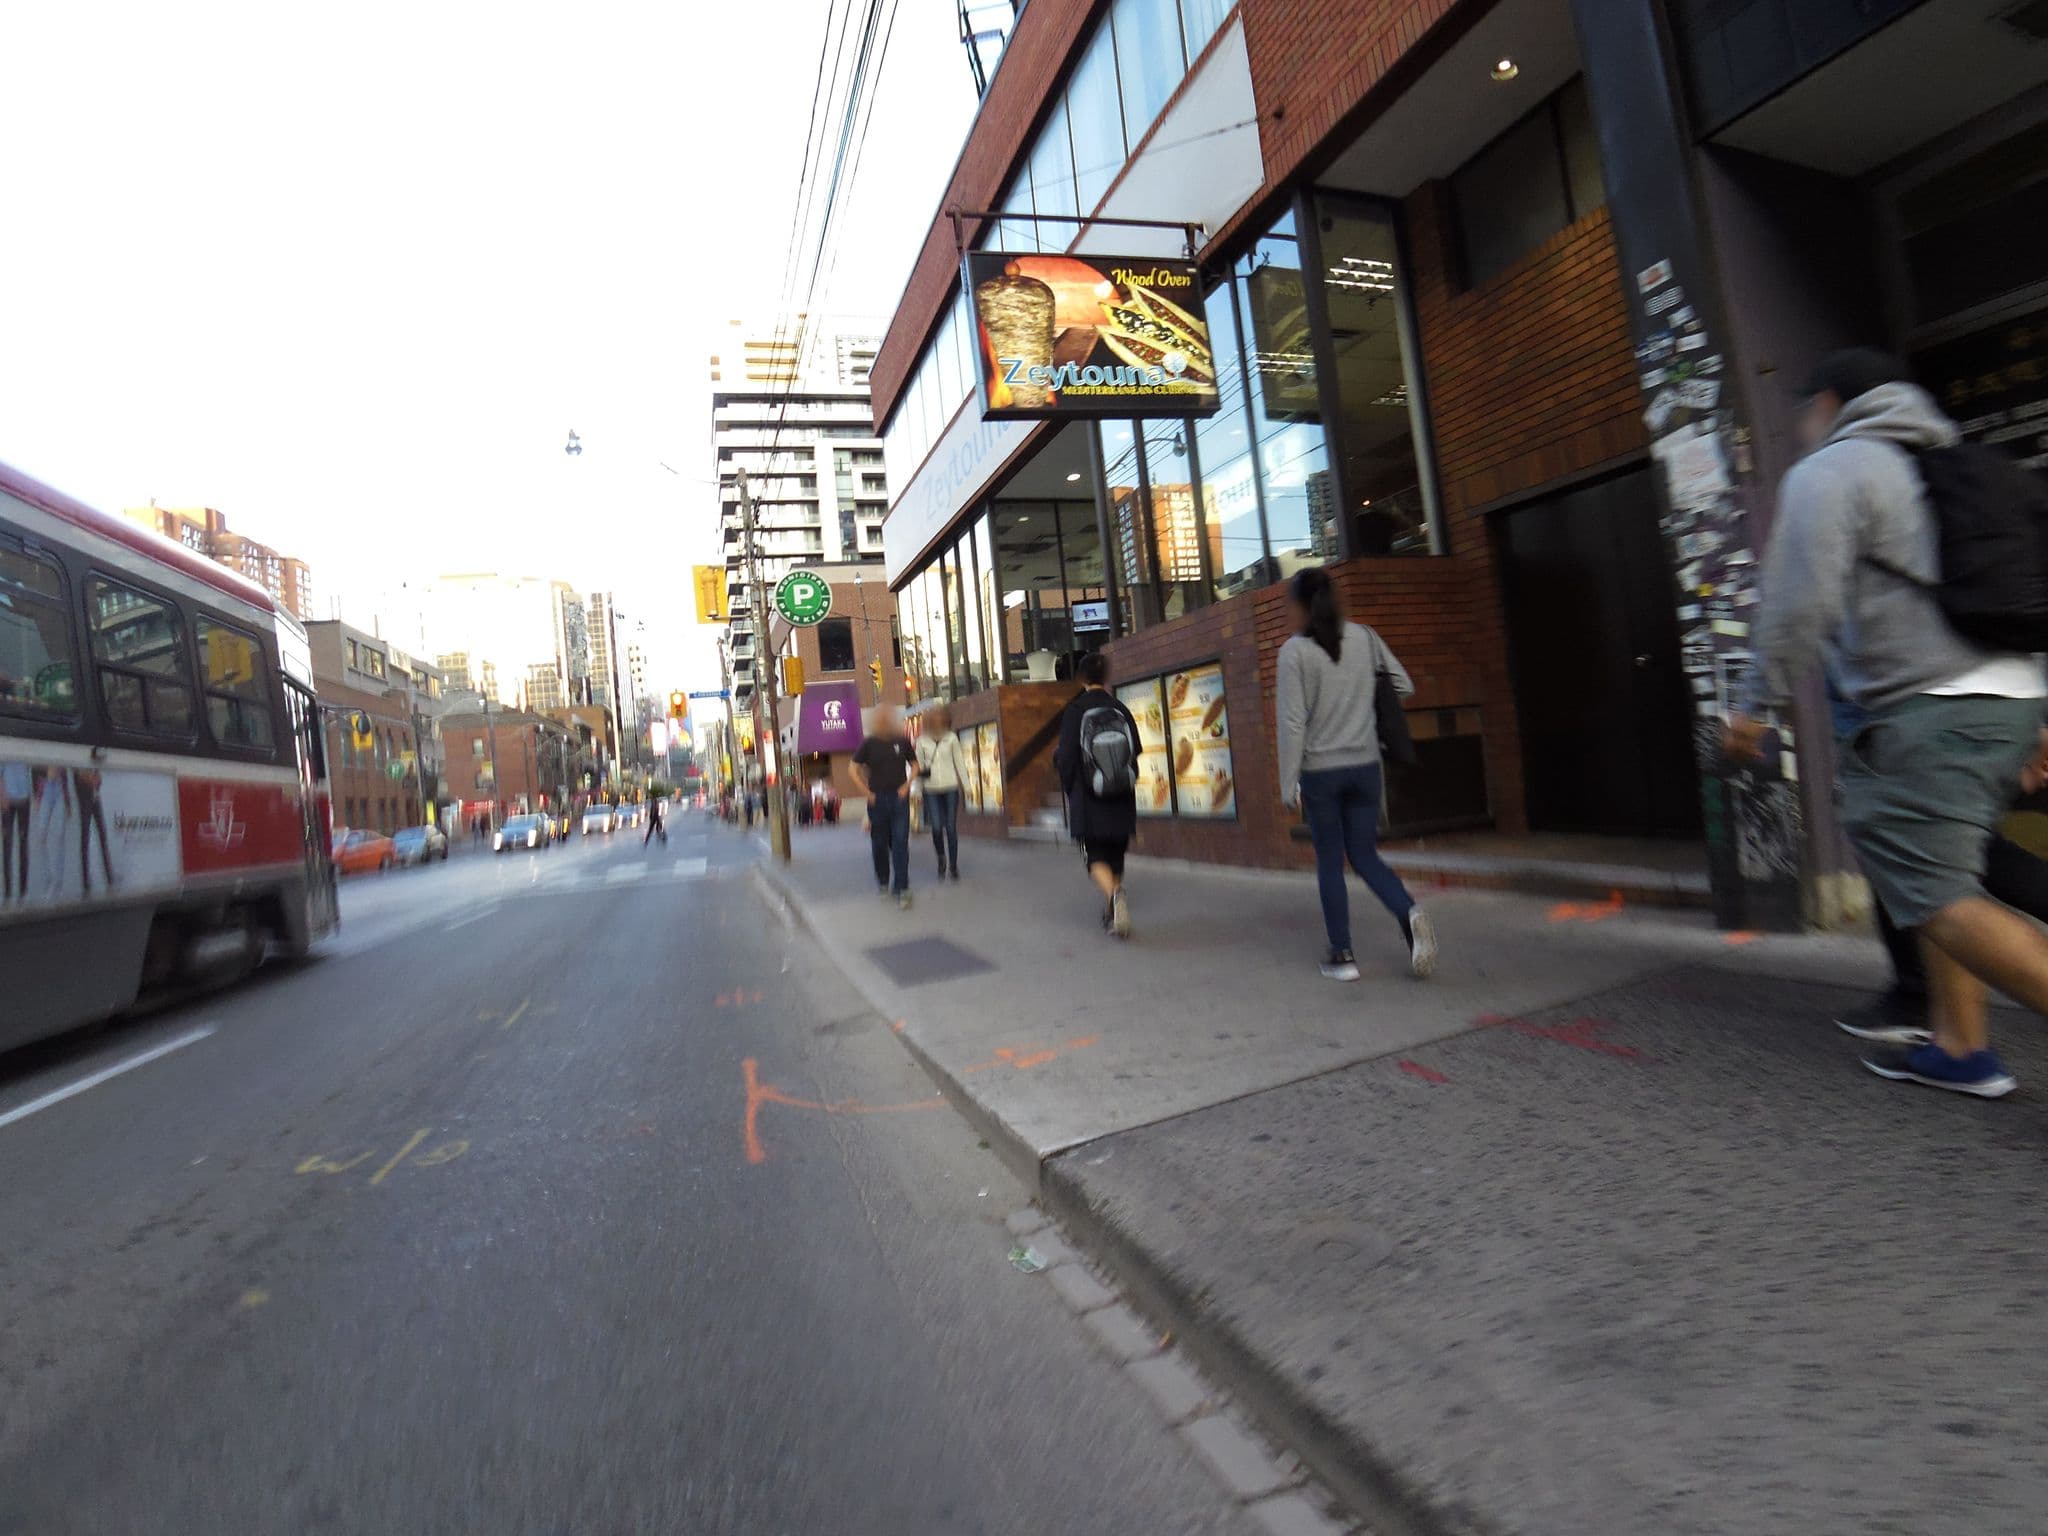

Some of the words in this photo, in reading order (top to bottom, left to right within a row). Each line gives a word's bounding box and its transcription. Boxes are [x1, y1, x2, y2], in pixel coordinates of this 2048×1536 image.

[1111, 267, 1157, 286] Wood
[1157, 269, 1191, 287] Oven
[998, 358, 1170, 391] Zeytouna
[778, 572, 826, 593] MUNICIPAL
[793, 584, 814, 605] P
[778, 600, 829, 623] PARKING
